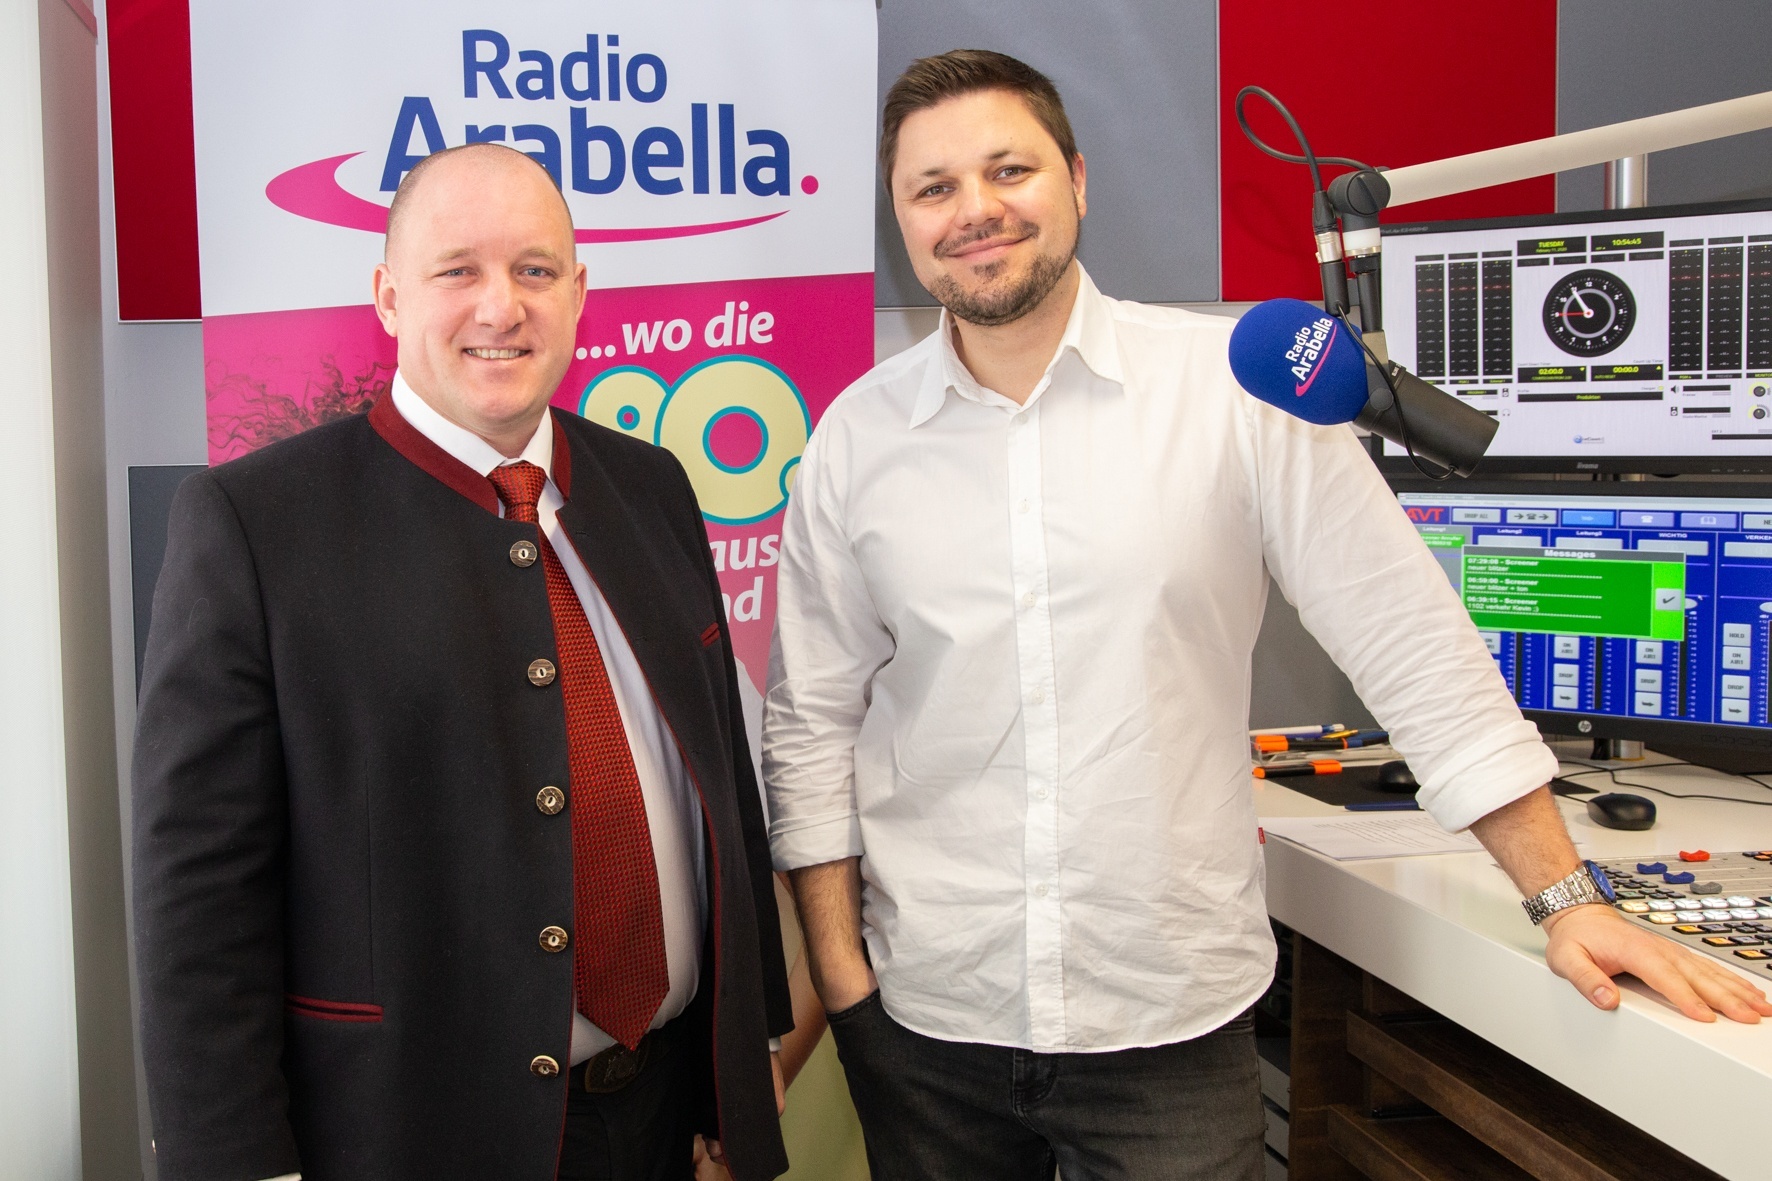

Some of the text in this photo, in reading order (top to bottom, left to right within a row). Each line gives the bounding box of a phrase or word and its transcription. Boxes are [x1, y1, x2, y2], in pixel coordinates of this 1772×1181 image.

[462, 28, 667, 103] Radio
[1612, 238, 1642, 246] 10:54:45
[704, 300, 775, 349] die
[1285, 326, 1312, 362] Radio
[1405, 507, 1444, 522] AVT
[1543, 549, 1596, 559] Messages
[1505, 559, 1539, 567] Screener
[1505, 578, 1539, 586] Screener
[1504, 597, 1538, 605] Screener
[1579, 721, 1591, 732] hp
